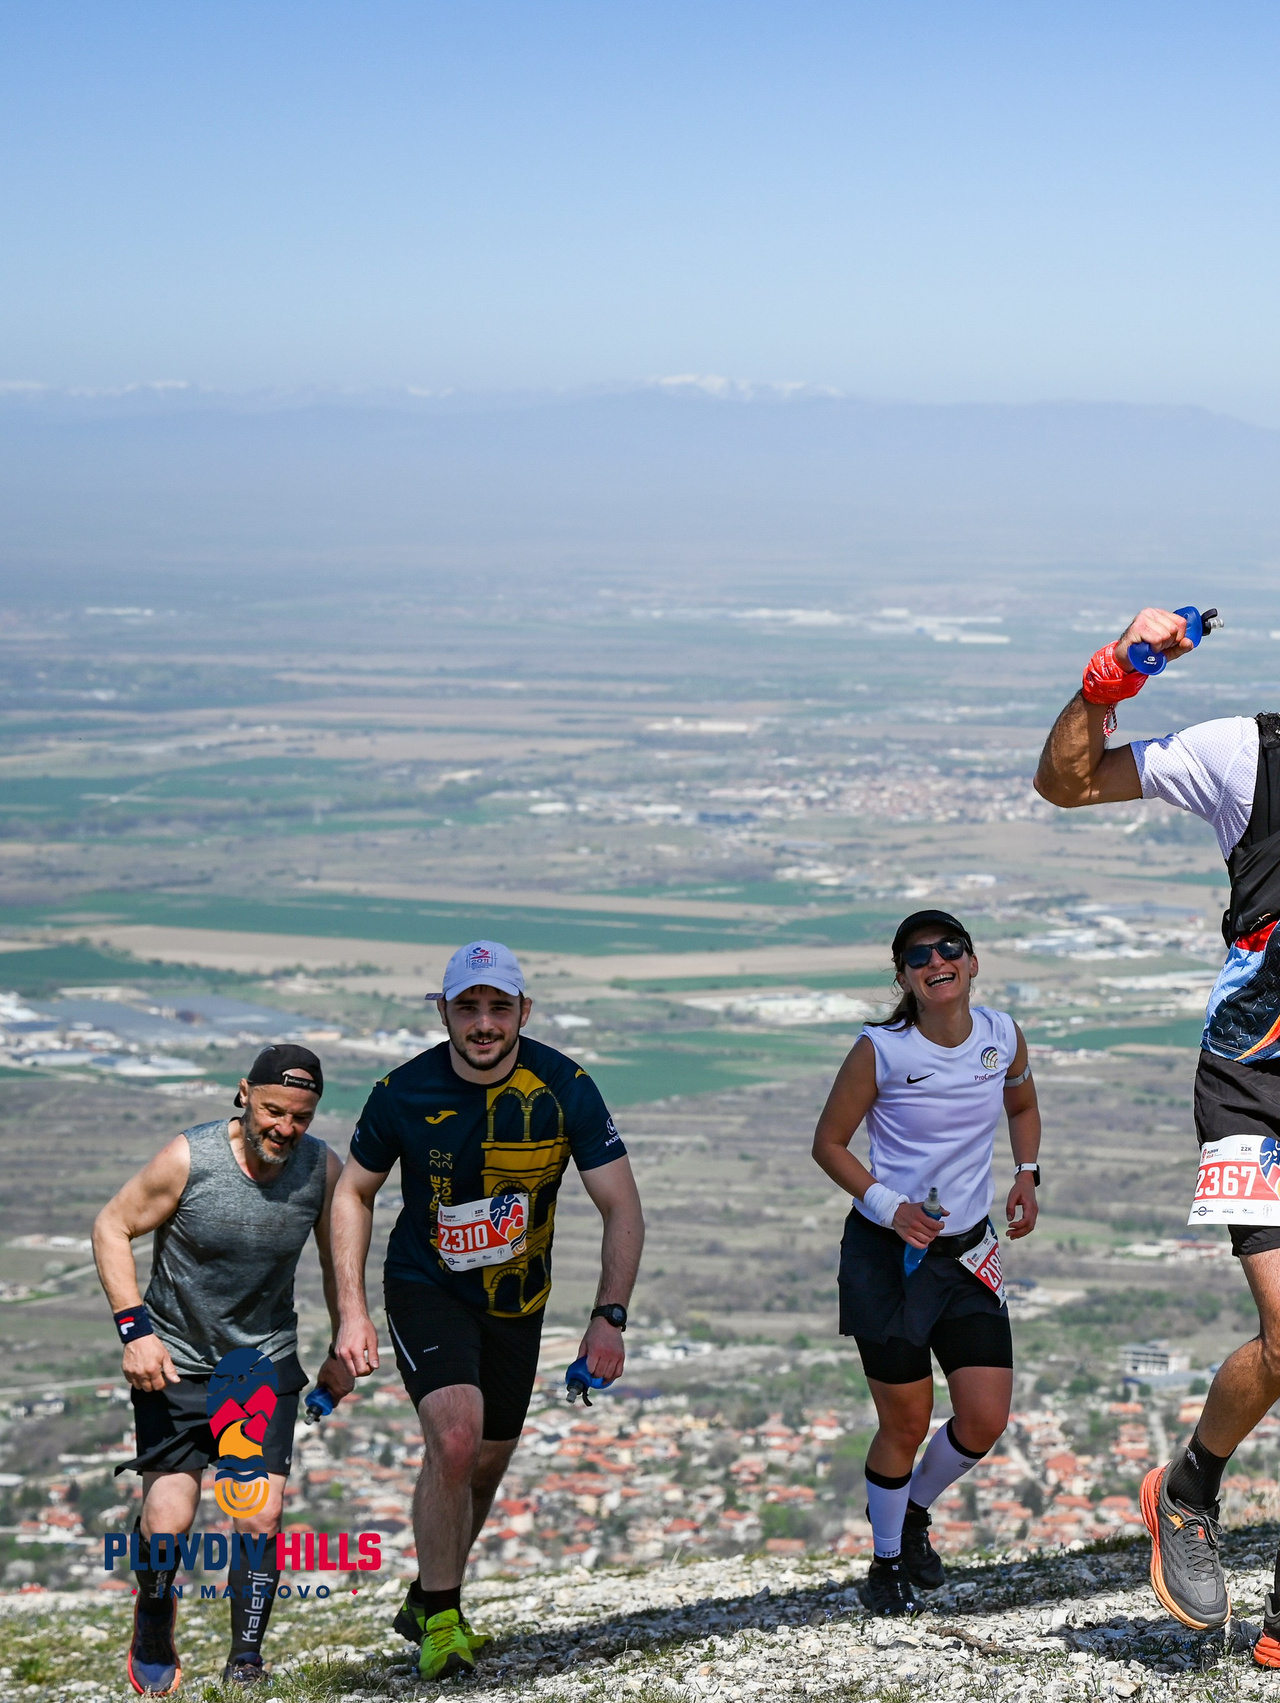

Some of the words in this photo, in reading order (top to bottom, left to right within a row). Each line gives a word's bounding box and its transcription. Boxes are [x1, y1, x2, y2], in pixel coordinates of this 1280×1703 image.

[429, 1149, 441, 1169] 20
[441, 1152, 453, 1170] 24
[1195, 1166, 1257, 1197] 2367
[440, 1224, 489, 1252] 2310
